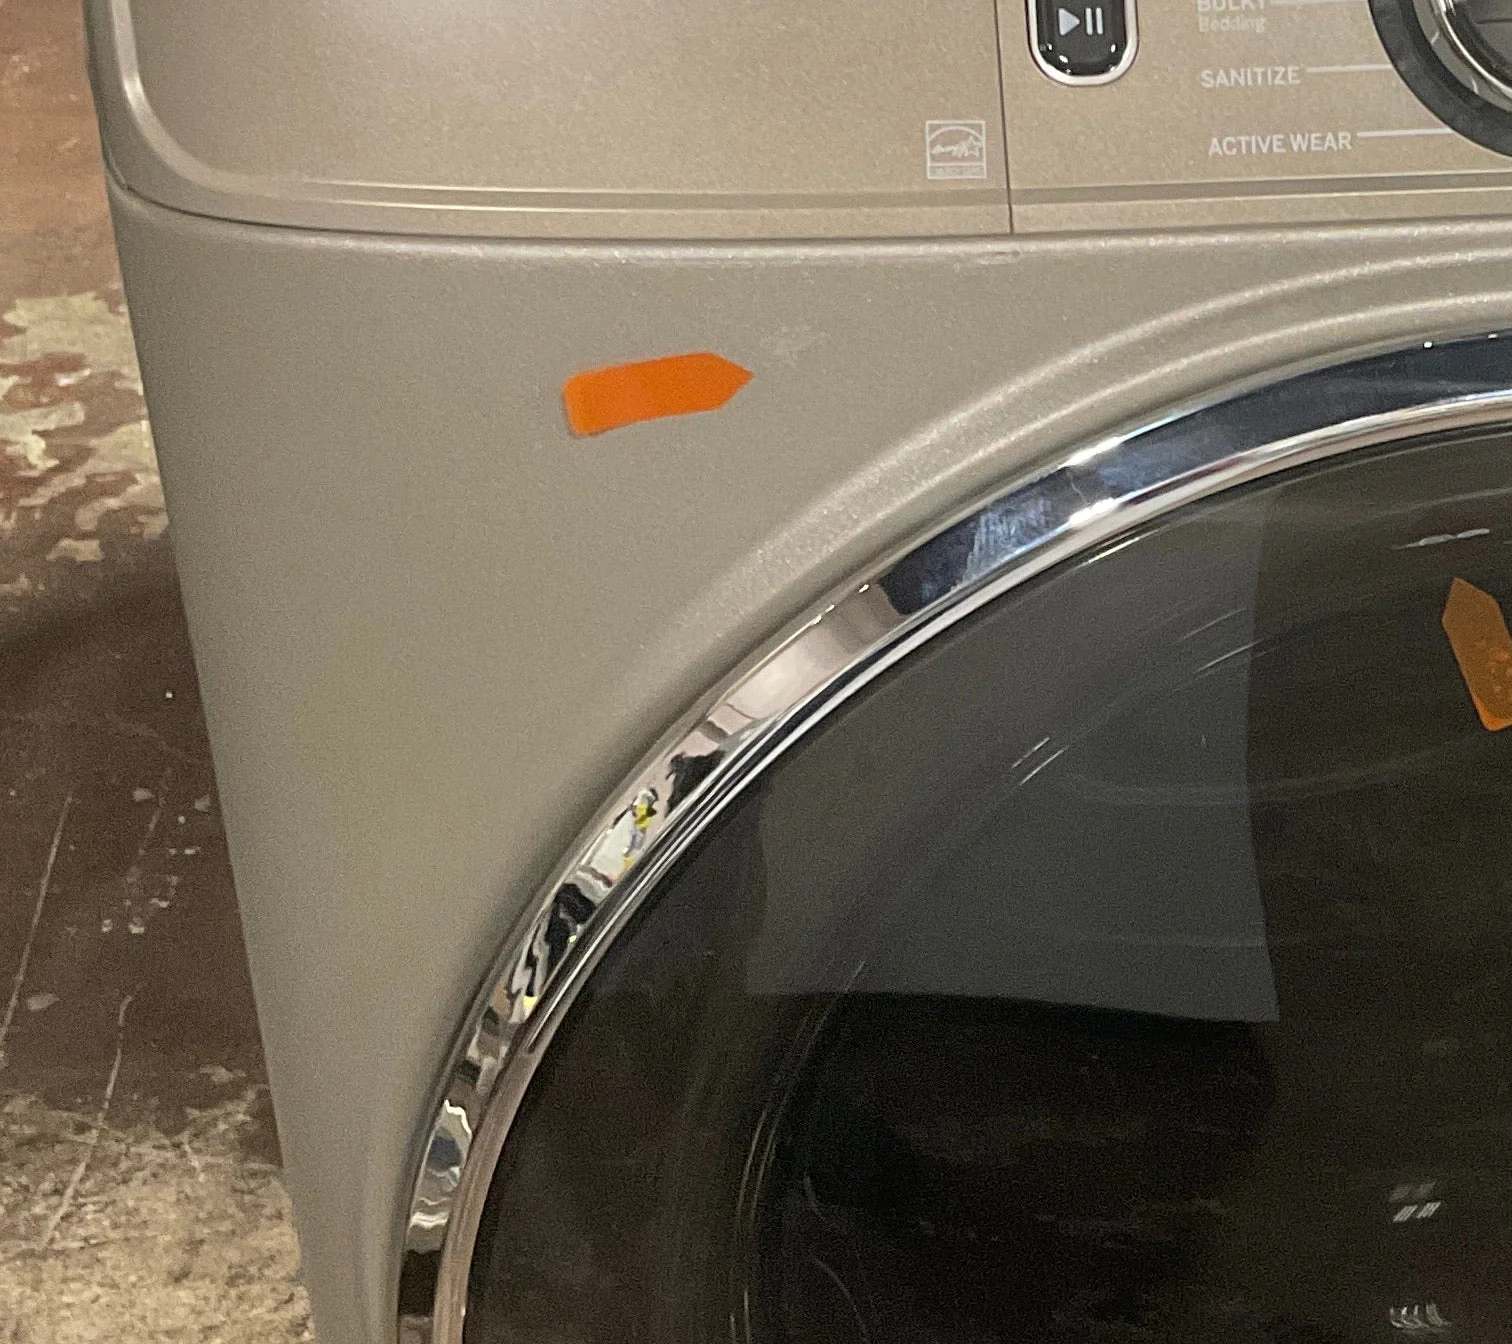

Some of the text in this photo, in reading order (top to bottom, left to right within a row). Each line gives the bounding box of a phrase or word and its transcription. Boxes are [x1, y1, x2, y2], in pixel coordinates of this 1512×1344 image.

[1199, 15, 1267, 33] Bedding
[1201, 66, 1300, 88] SANITIZE
[1208, 131, 1353, 156] ACTIVE WEAR
